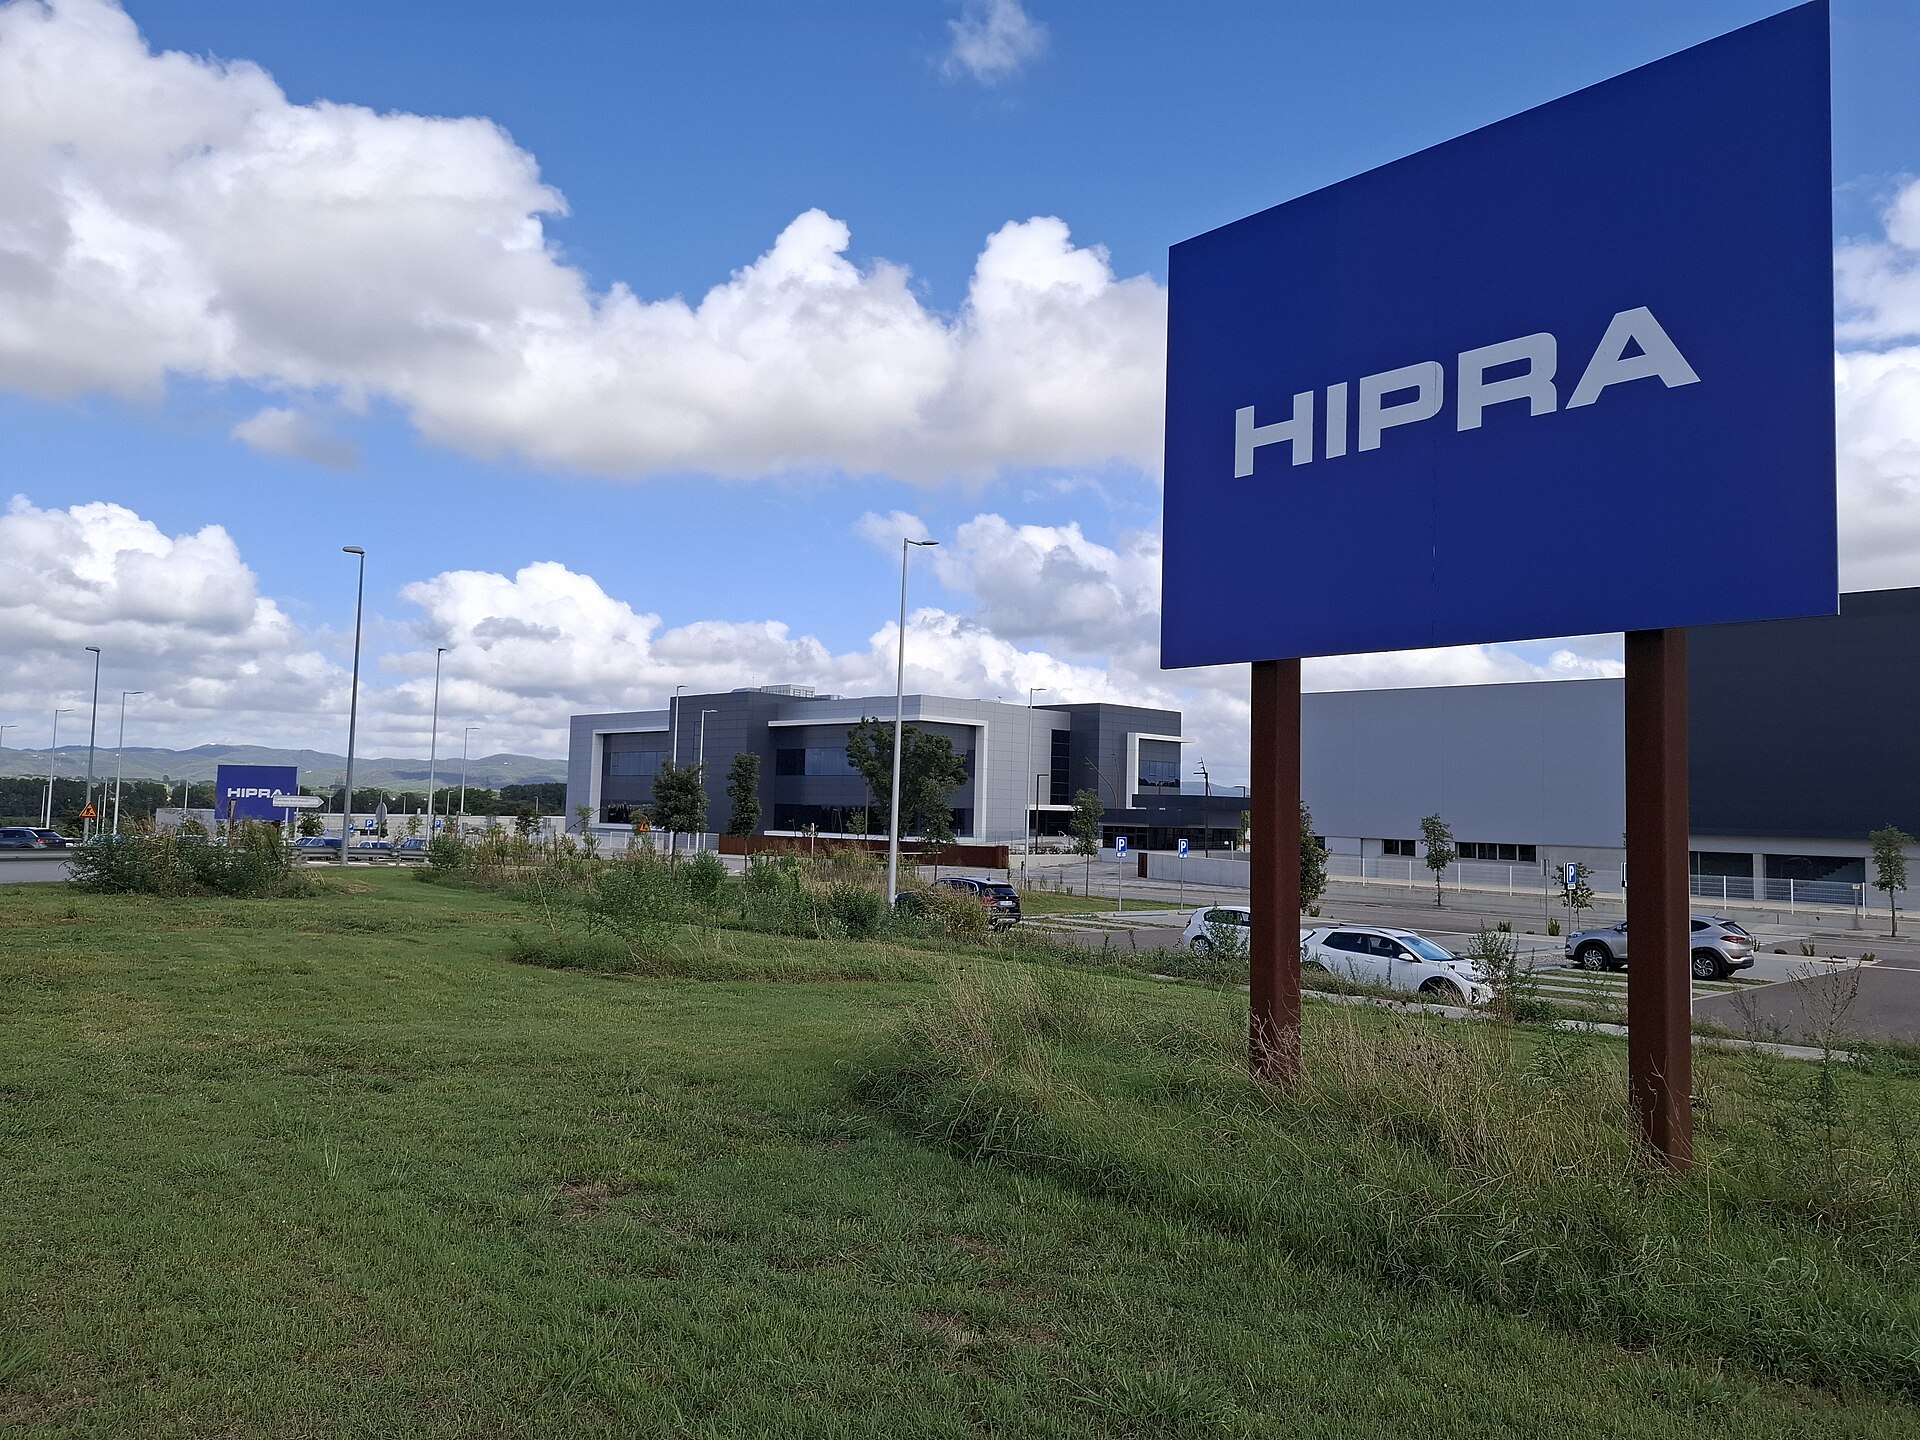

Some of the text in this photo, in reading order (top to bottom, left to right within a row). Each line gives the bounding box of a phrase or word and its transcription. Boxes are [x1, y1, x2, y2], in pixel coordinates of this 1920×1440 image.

[1234, 306, 1701, 478] HIPRA
[227, 787, 283, 799] HIPRA
[1118, 838, 1125, 851] P
[1180, 840, 1187, 853] P
[1568, 865, 1575, 882] P
